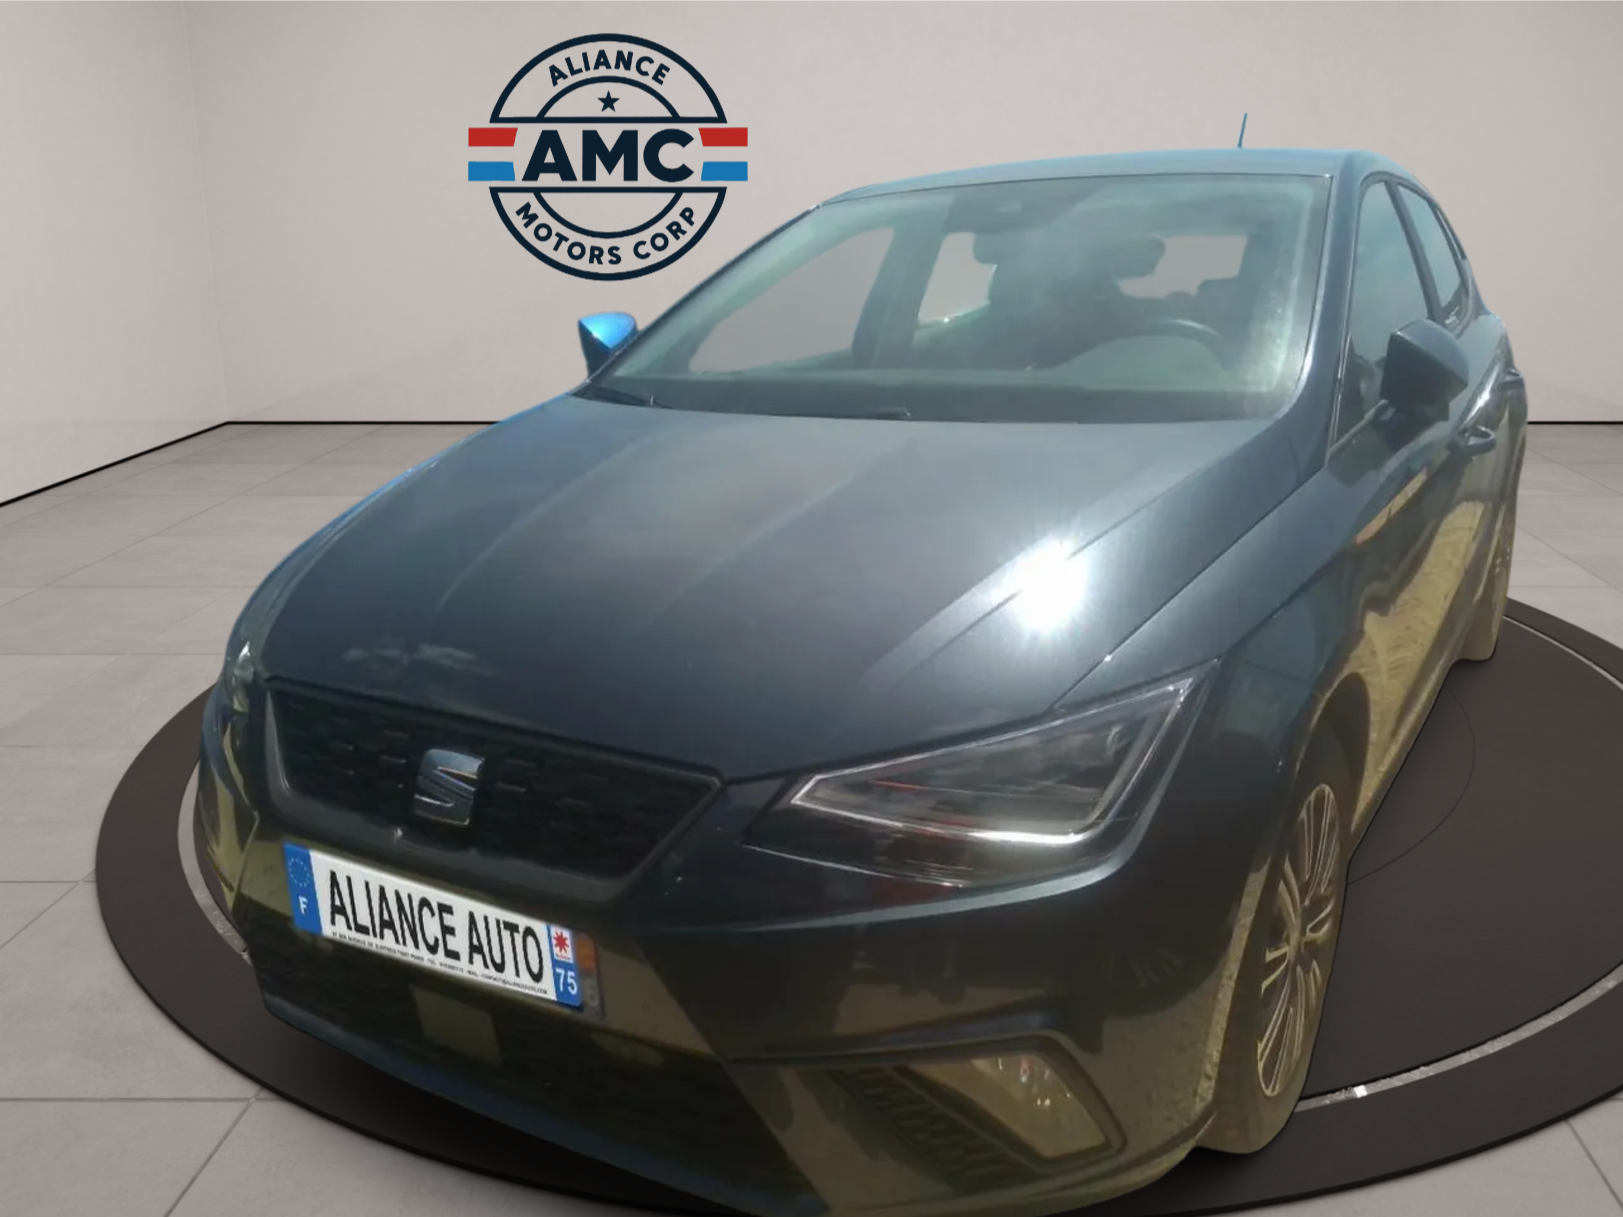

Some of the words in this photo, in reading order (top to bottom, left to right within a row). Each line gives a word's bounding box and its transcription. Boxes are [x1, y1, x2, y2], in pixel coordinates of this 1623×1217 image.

[298, 895, 308, 914] F
[329, 869, 461, 962] ALIANCE
[468, 911, 544, 984] AUTO
[555, 967, 578, 995] 75
